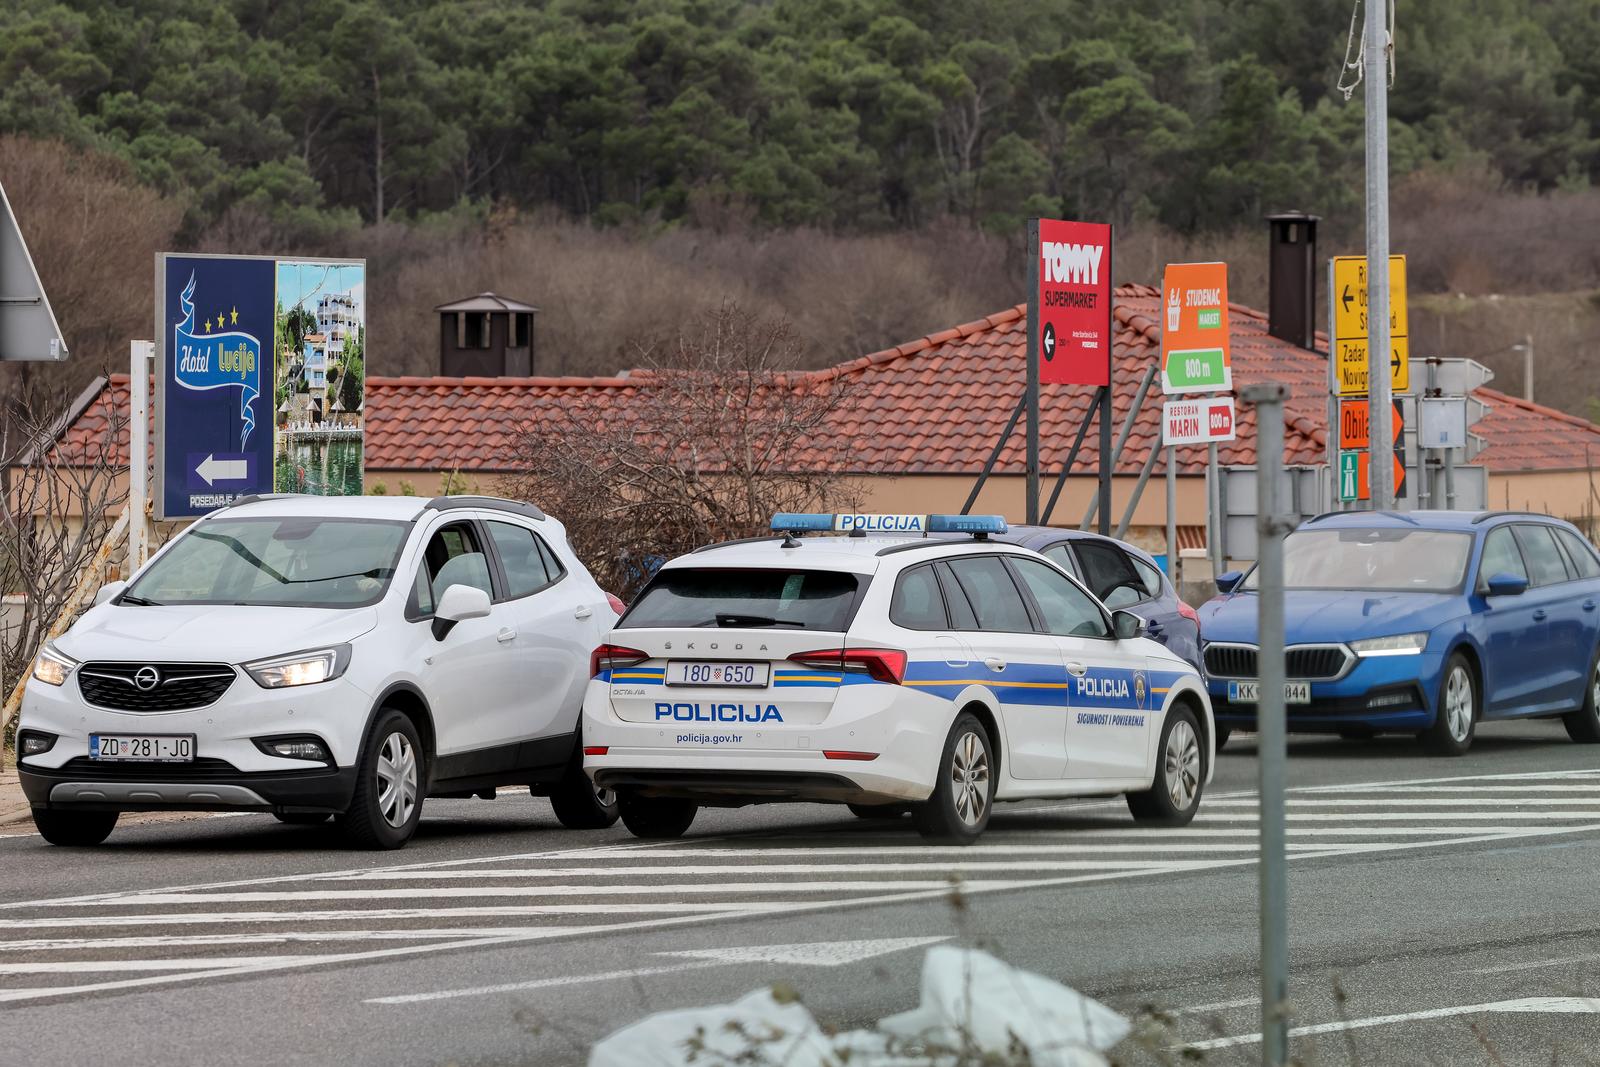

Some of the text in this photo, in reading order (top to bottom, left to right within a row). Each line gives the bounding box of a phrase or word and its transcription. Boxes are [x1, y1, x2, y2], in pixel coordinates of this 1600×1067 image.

[1042, 241, 1103, 285] TOMMY
[1044, 290, 1098, 309] SUPERMARKET
[1185, 288, 1221, 307] STUDENAC
[1199, 312, 1220, 326] MARKET
[180, 345, 211, 373] Hotel
[1343, 344, 1365, 362] Zadar
[1185, 359, 1211, 379] 800 m
[1169, 405, 1199, 417] RESTORAN
[1169, 418, 1199, 438] MARIN
[1210, 413, 1230, 429] 800 m
[841, 515, 922, 530] POLICIJA
[683, 665, 754, 683] 180 650
[1077, 677, 1130, 698] POLICIJA
[1239, 684, 1254, 698] KK
[655, 703, 784, 722] POLICIJA
[1077, 712, 1109, 726] SIGURNOST
[1108, 714, 1113, 725] I
[100, 739, 119, 756] ZD
[676, 733, 743, 744] policija.gov.hr
